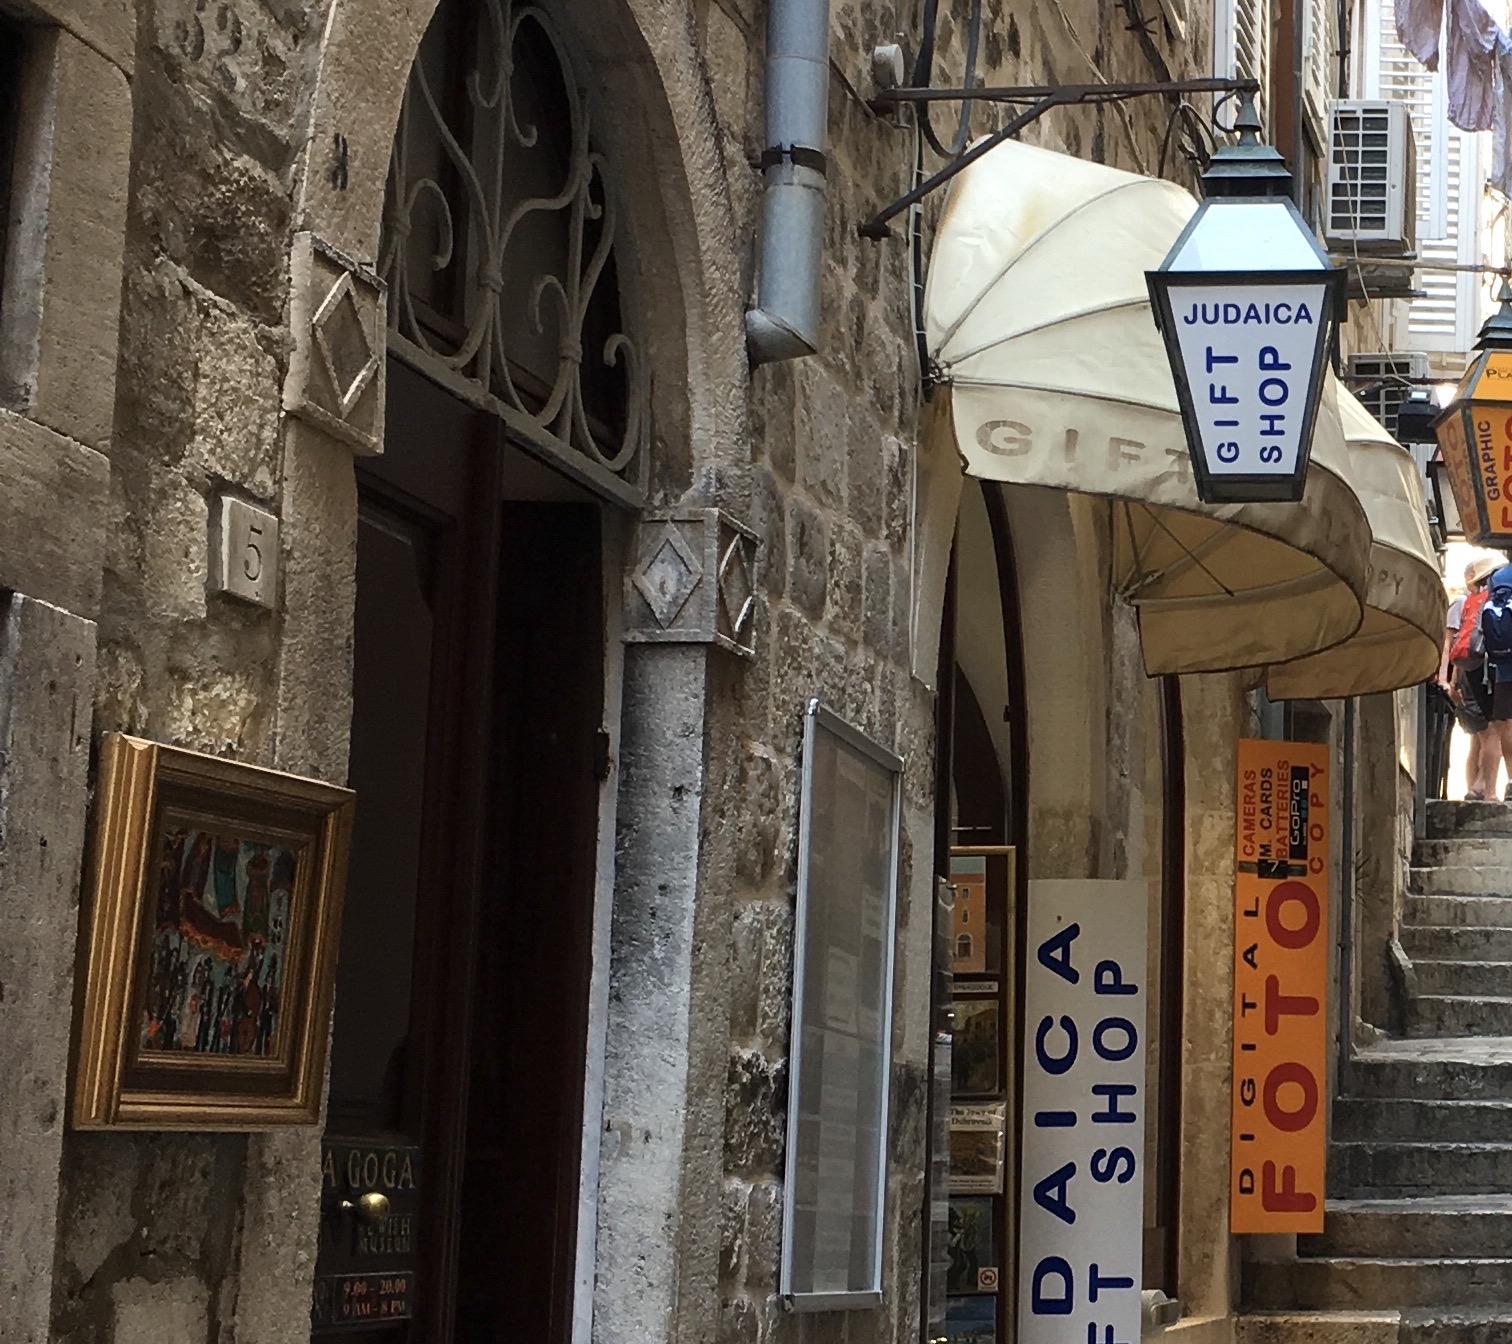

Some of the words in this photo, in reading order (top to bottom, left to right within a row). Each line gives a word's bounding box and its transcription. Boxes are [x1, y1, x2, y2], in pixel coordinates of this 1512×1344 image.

[1184, 303, 1313, 325] JUDAICA
[1206, 346, 1240, 464] GIFT
[1259, 345, 1291, 464] SHOP
[1477, 420, 1501, 501] GRAPHIC
[243, 524, 264, 582] 5
[1242, 769, 1257, 856] CAMERAS
[1259, 767, 1273, 830] CARDS
[1275, 759, 1290, 858] BATTERIES
[1290, 779, 1301, 845] GoPro
[1308, 762, 1325, 875] COPY
[1089, 958, 1139, 1185] SHOP
[1238, 895, 1261, 1196] DIGITAL
[1261, 880, 1321, 1213] FOTO
